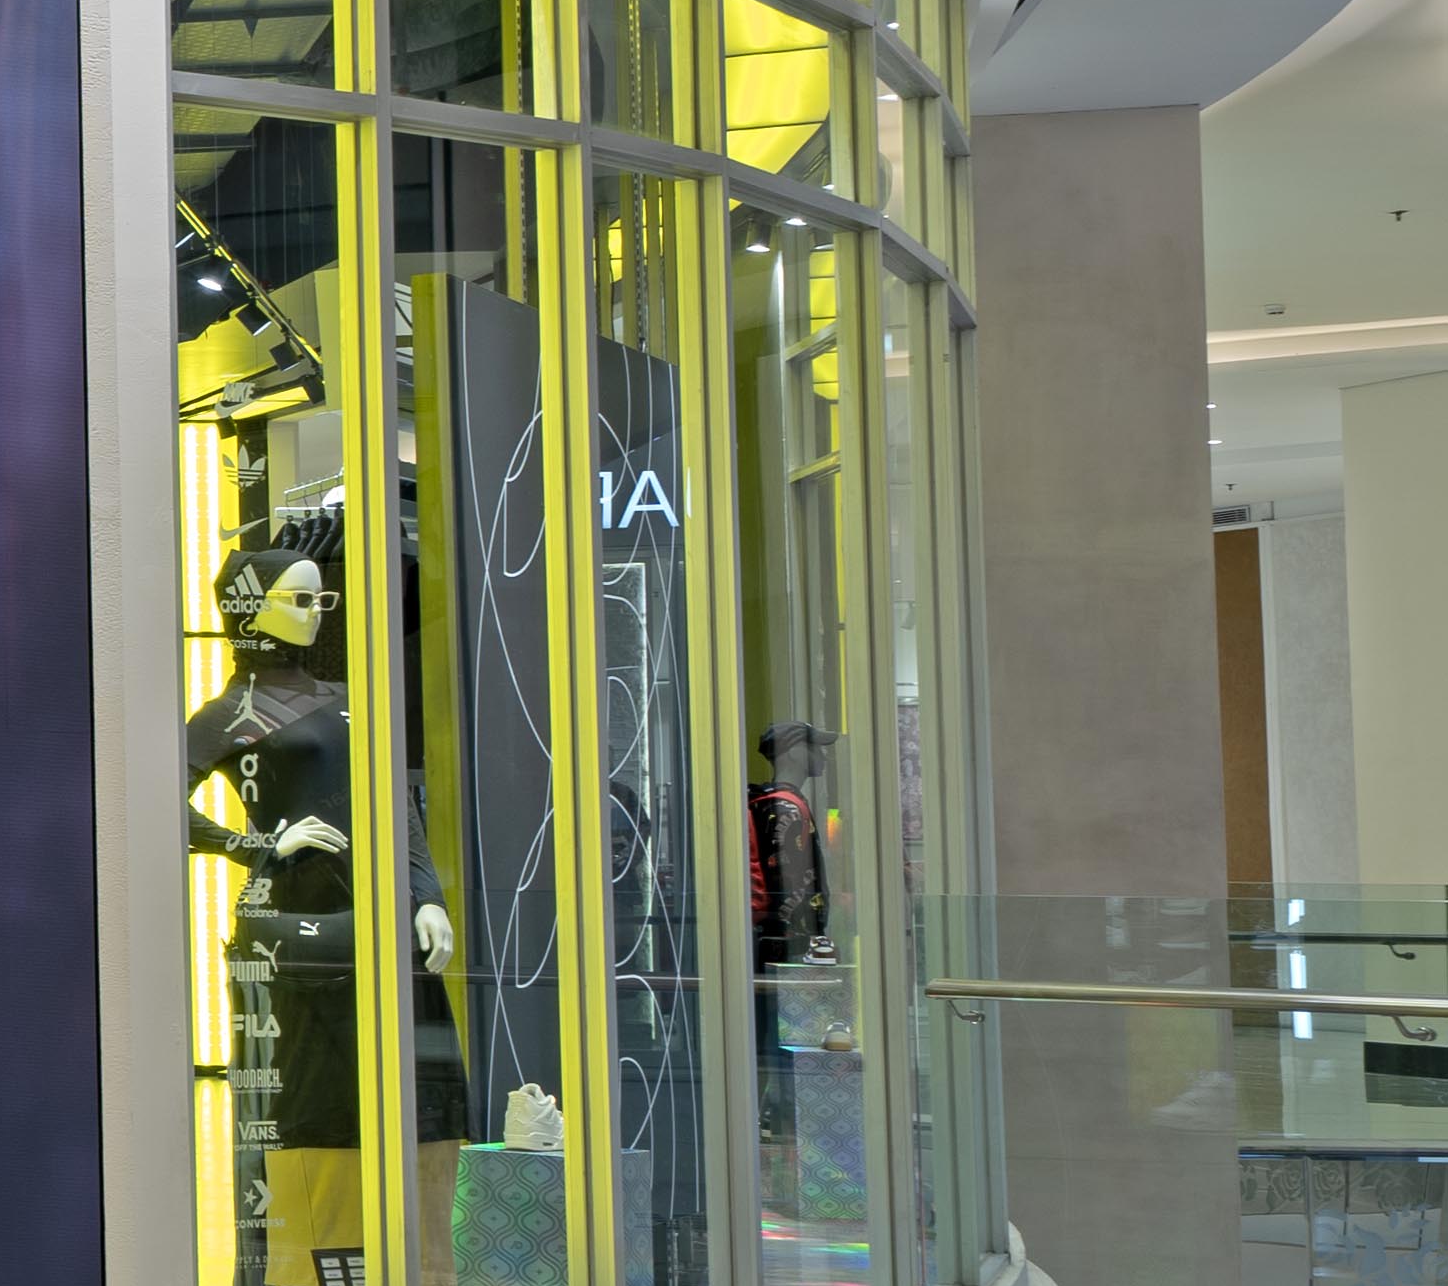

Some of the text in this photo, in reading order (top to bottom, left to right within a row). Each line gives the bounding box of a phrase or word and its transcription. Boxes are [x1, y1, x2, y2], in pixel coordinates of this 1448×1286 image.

[220, 597, 271, 613] adidas
[242, 832, 277, 849] asics
[231, 1014, 282, 1038] FILA
[238, 1120, 278, 1141] VANS
